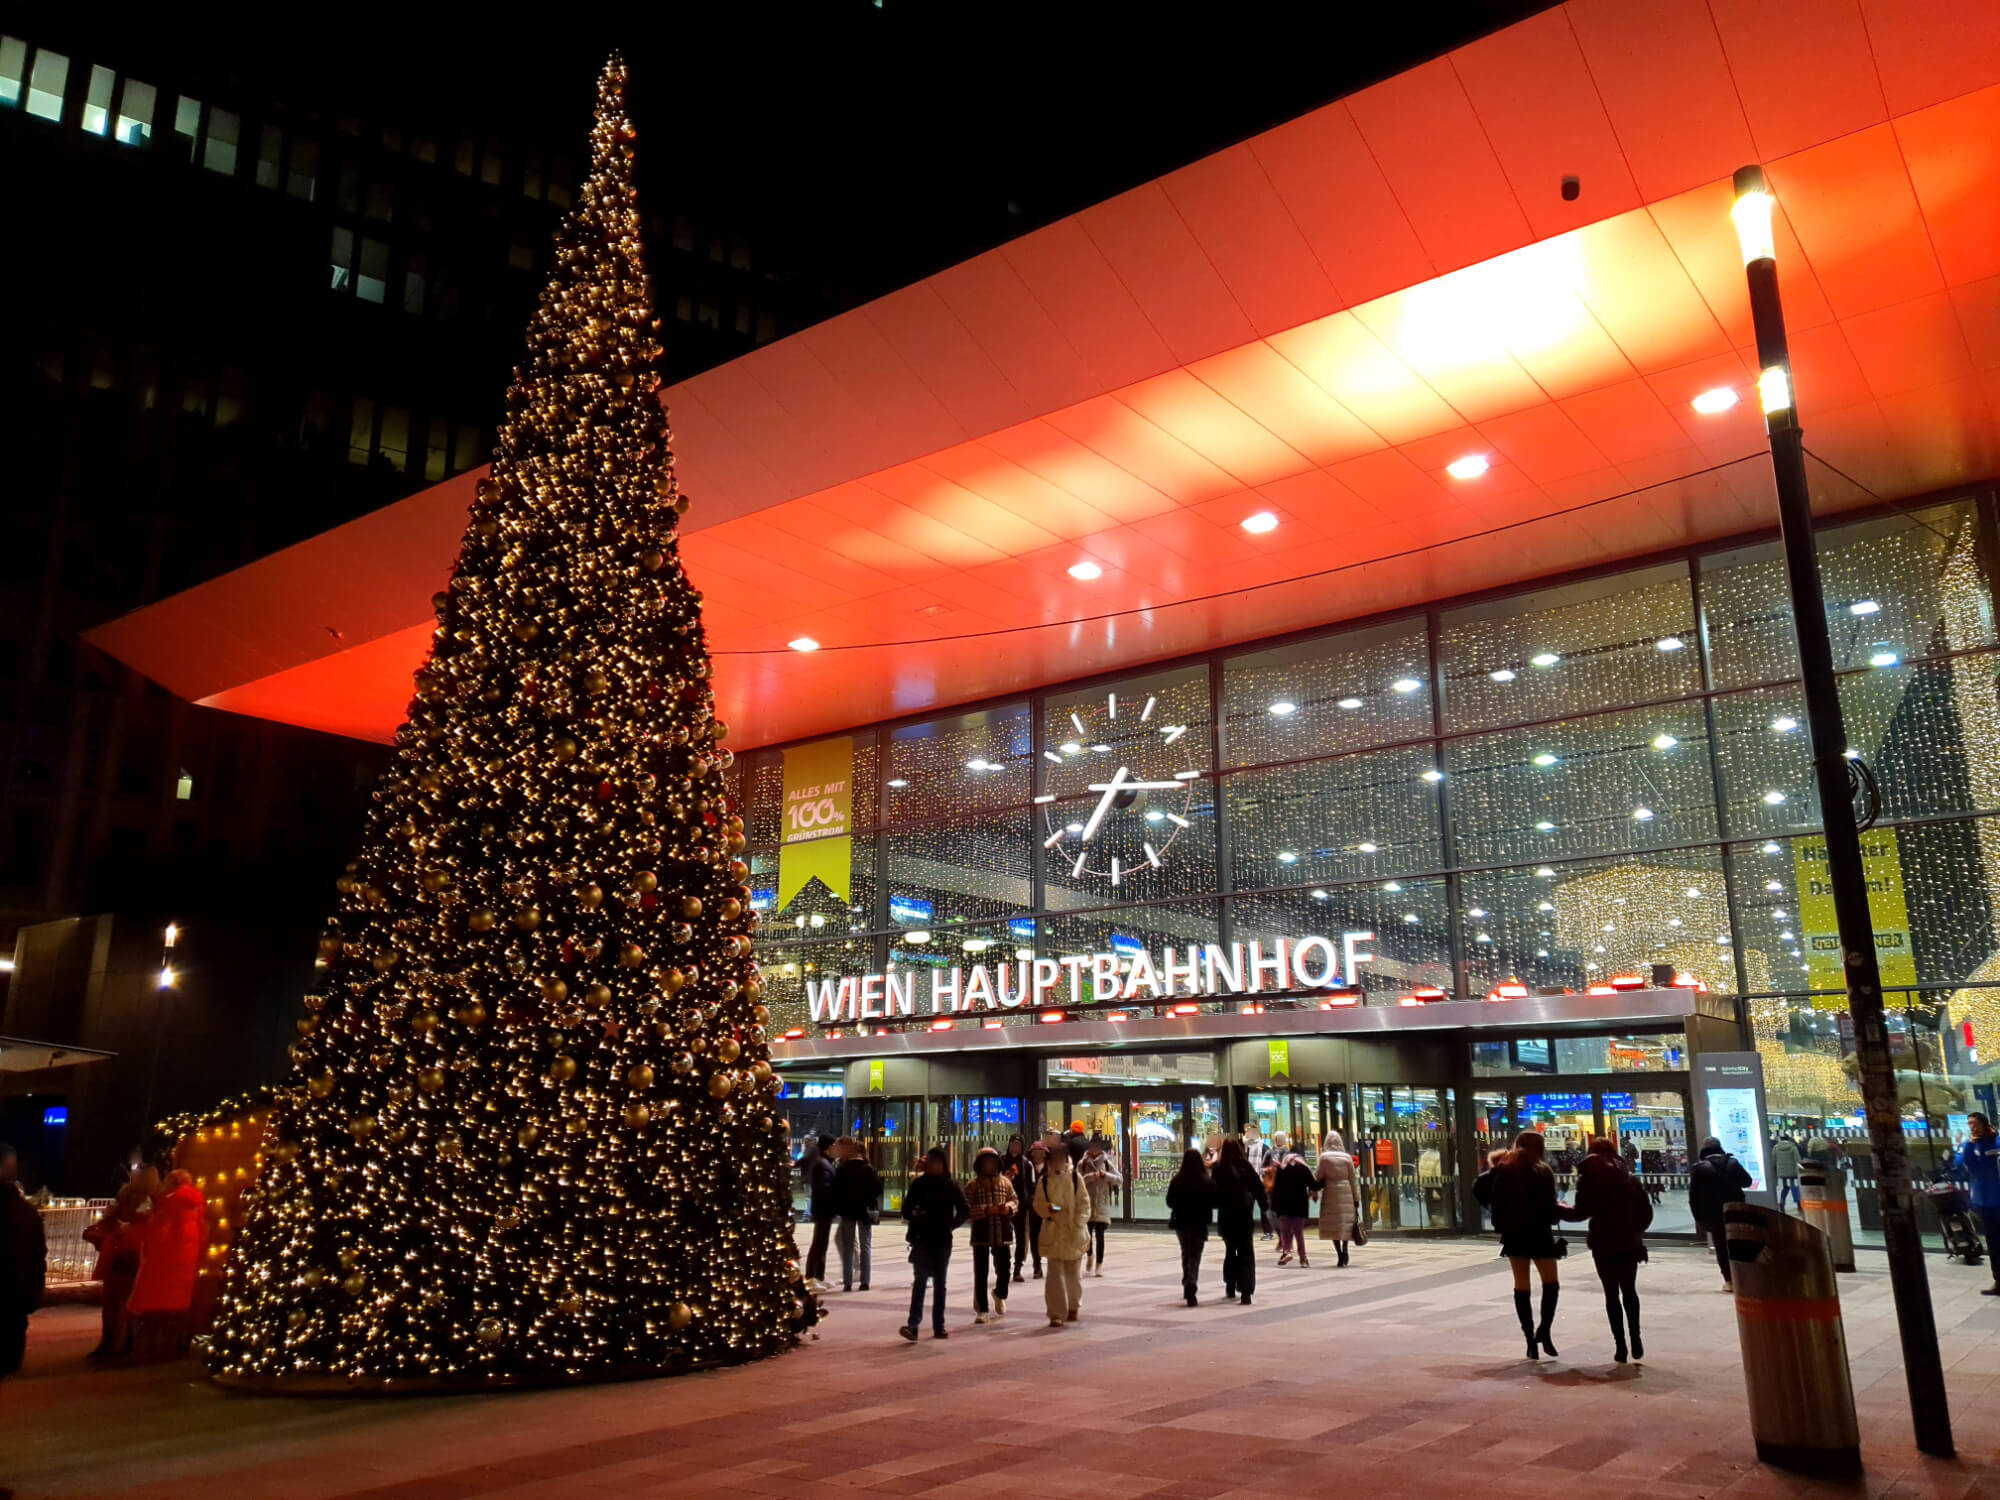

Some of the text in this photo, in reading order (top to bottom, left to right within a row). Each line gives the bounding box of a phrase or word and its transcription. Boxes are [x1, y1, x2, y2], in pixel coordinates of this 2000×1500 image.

[788, 781, 846, 801] ALLES MIT
[807, 931, 1376, 1022] WIEN HAUPTBAHNHOF
